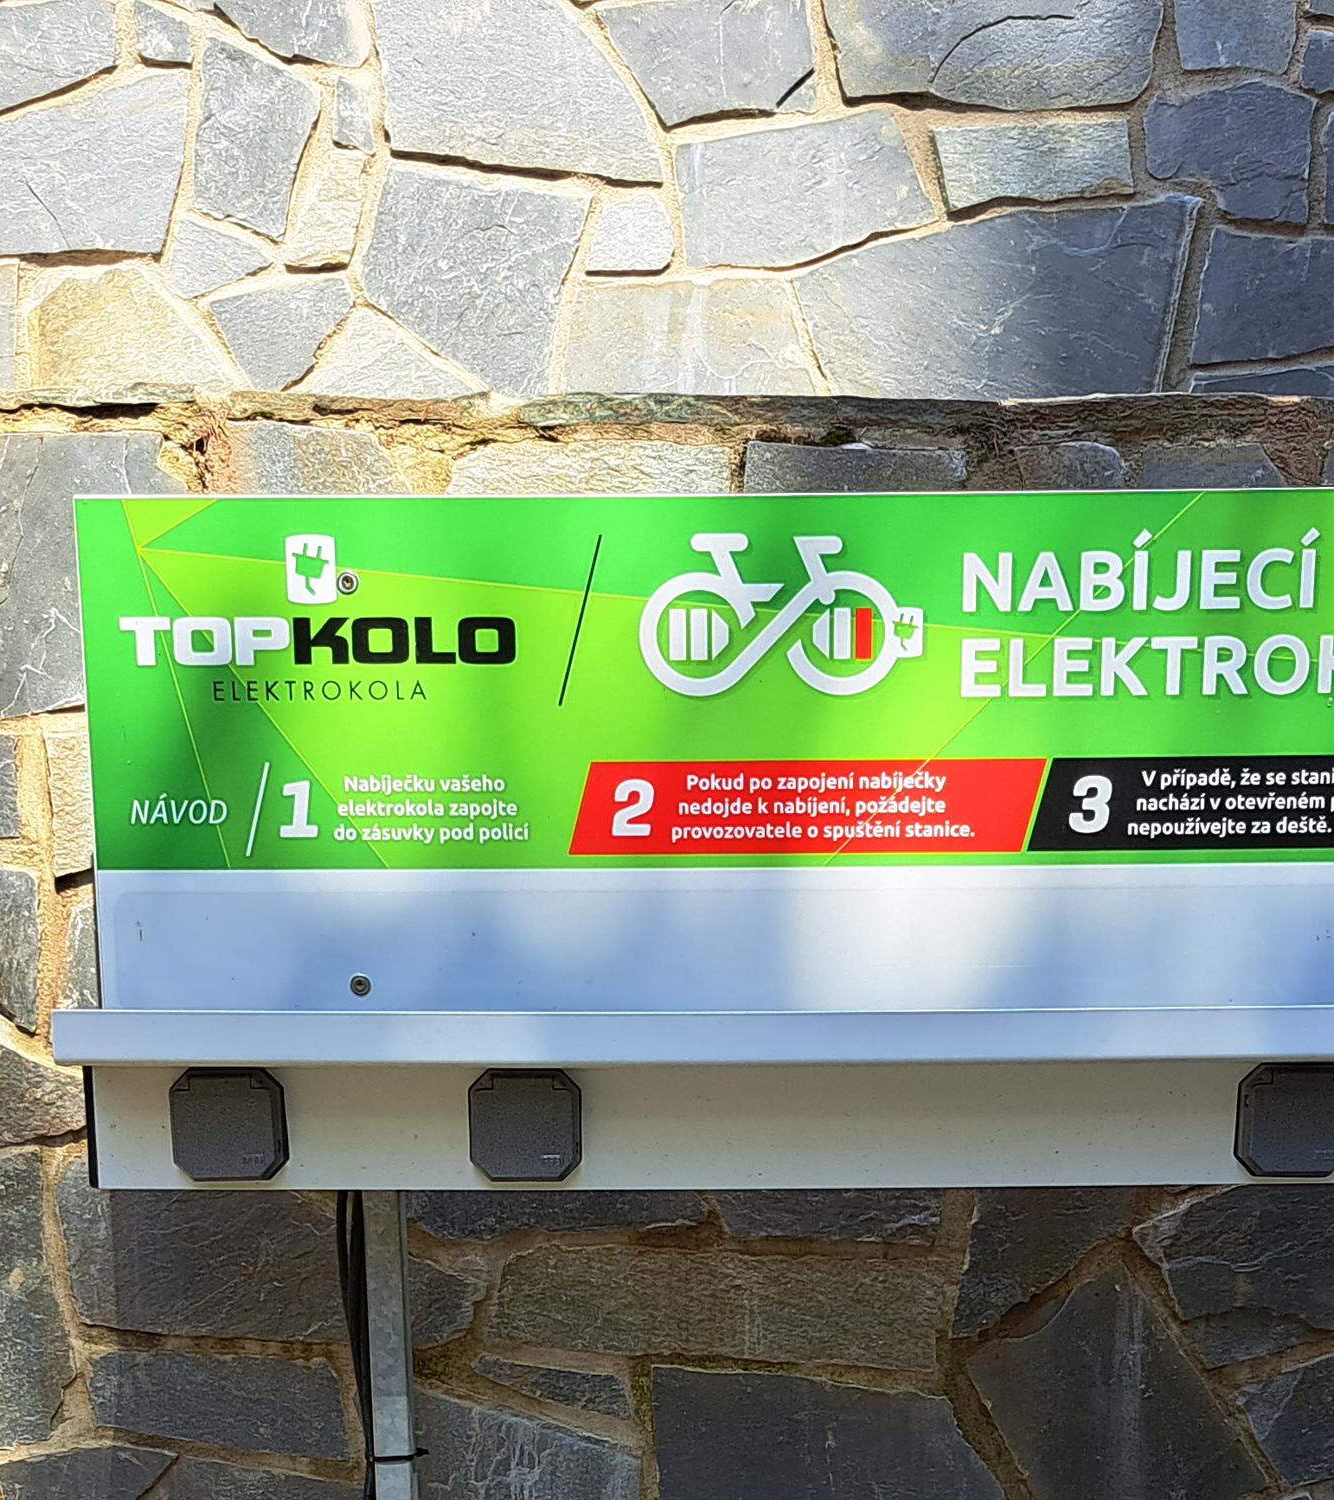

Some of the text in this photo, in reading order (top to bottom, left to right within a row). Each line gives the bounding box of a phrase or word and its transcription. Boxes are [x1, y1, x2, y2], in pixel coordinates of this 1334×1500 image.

[960, 528, 1322, 612] NABÍJECÍ
[119, 616, 517, 666] TOPKOLO
[213, 680, 427, 702] ELEKTROKOLA
[344, 774, 505, 797] Nabíječku vašeho
[686, 771, 946, 797] Pokud po zapojení nabíječky
[1141, 771, 1154, 786] V
[1160, 768, 1236, 790] případě,
[1241, 768, 1261, 785] že
[1267, 771, 1286, 785] se
[130, 792, 228, 826] NÁVOD
[279, 780, 319, 838] 1
[338, 799, 518, 822] elektrokola zapojte
[612, 778, 655, 837] 2
[678, 796, 946, 820] nedojde k nabíjení, požádejte
[1068, 775, 1113, 834] 3
[1136, 793, 1206, 811] nachází
[1210, 797, 1220, 810] v
[1225, 792, 1324, 810] otevřeném
[333, 822, 529, 845] do zásuvky pod policí
[671, 820, 975, 842] provozovatele o spuštění stanice.
[1127, 815, 1332, 838] nepoužívejte za deště.
